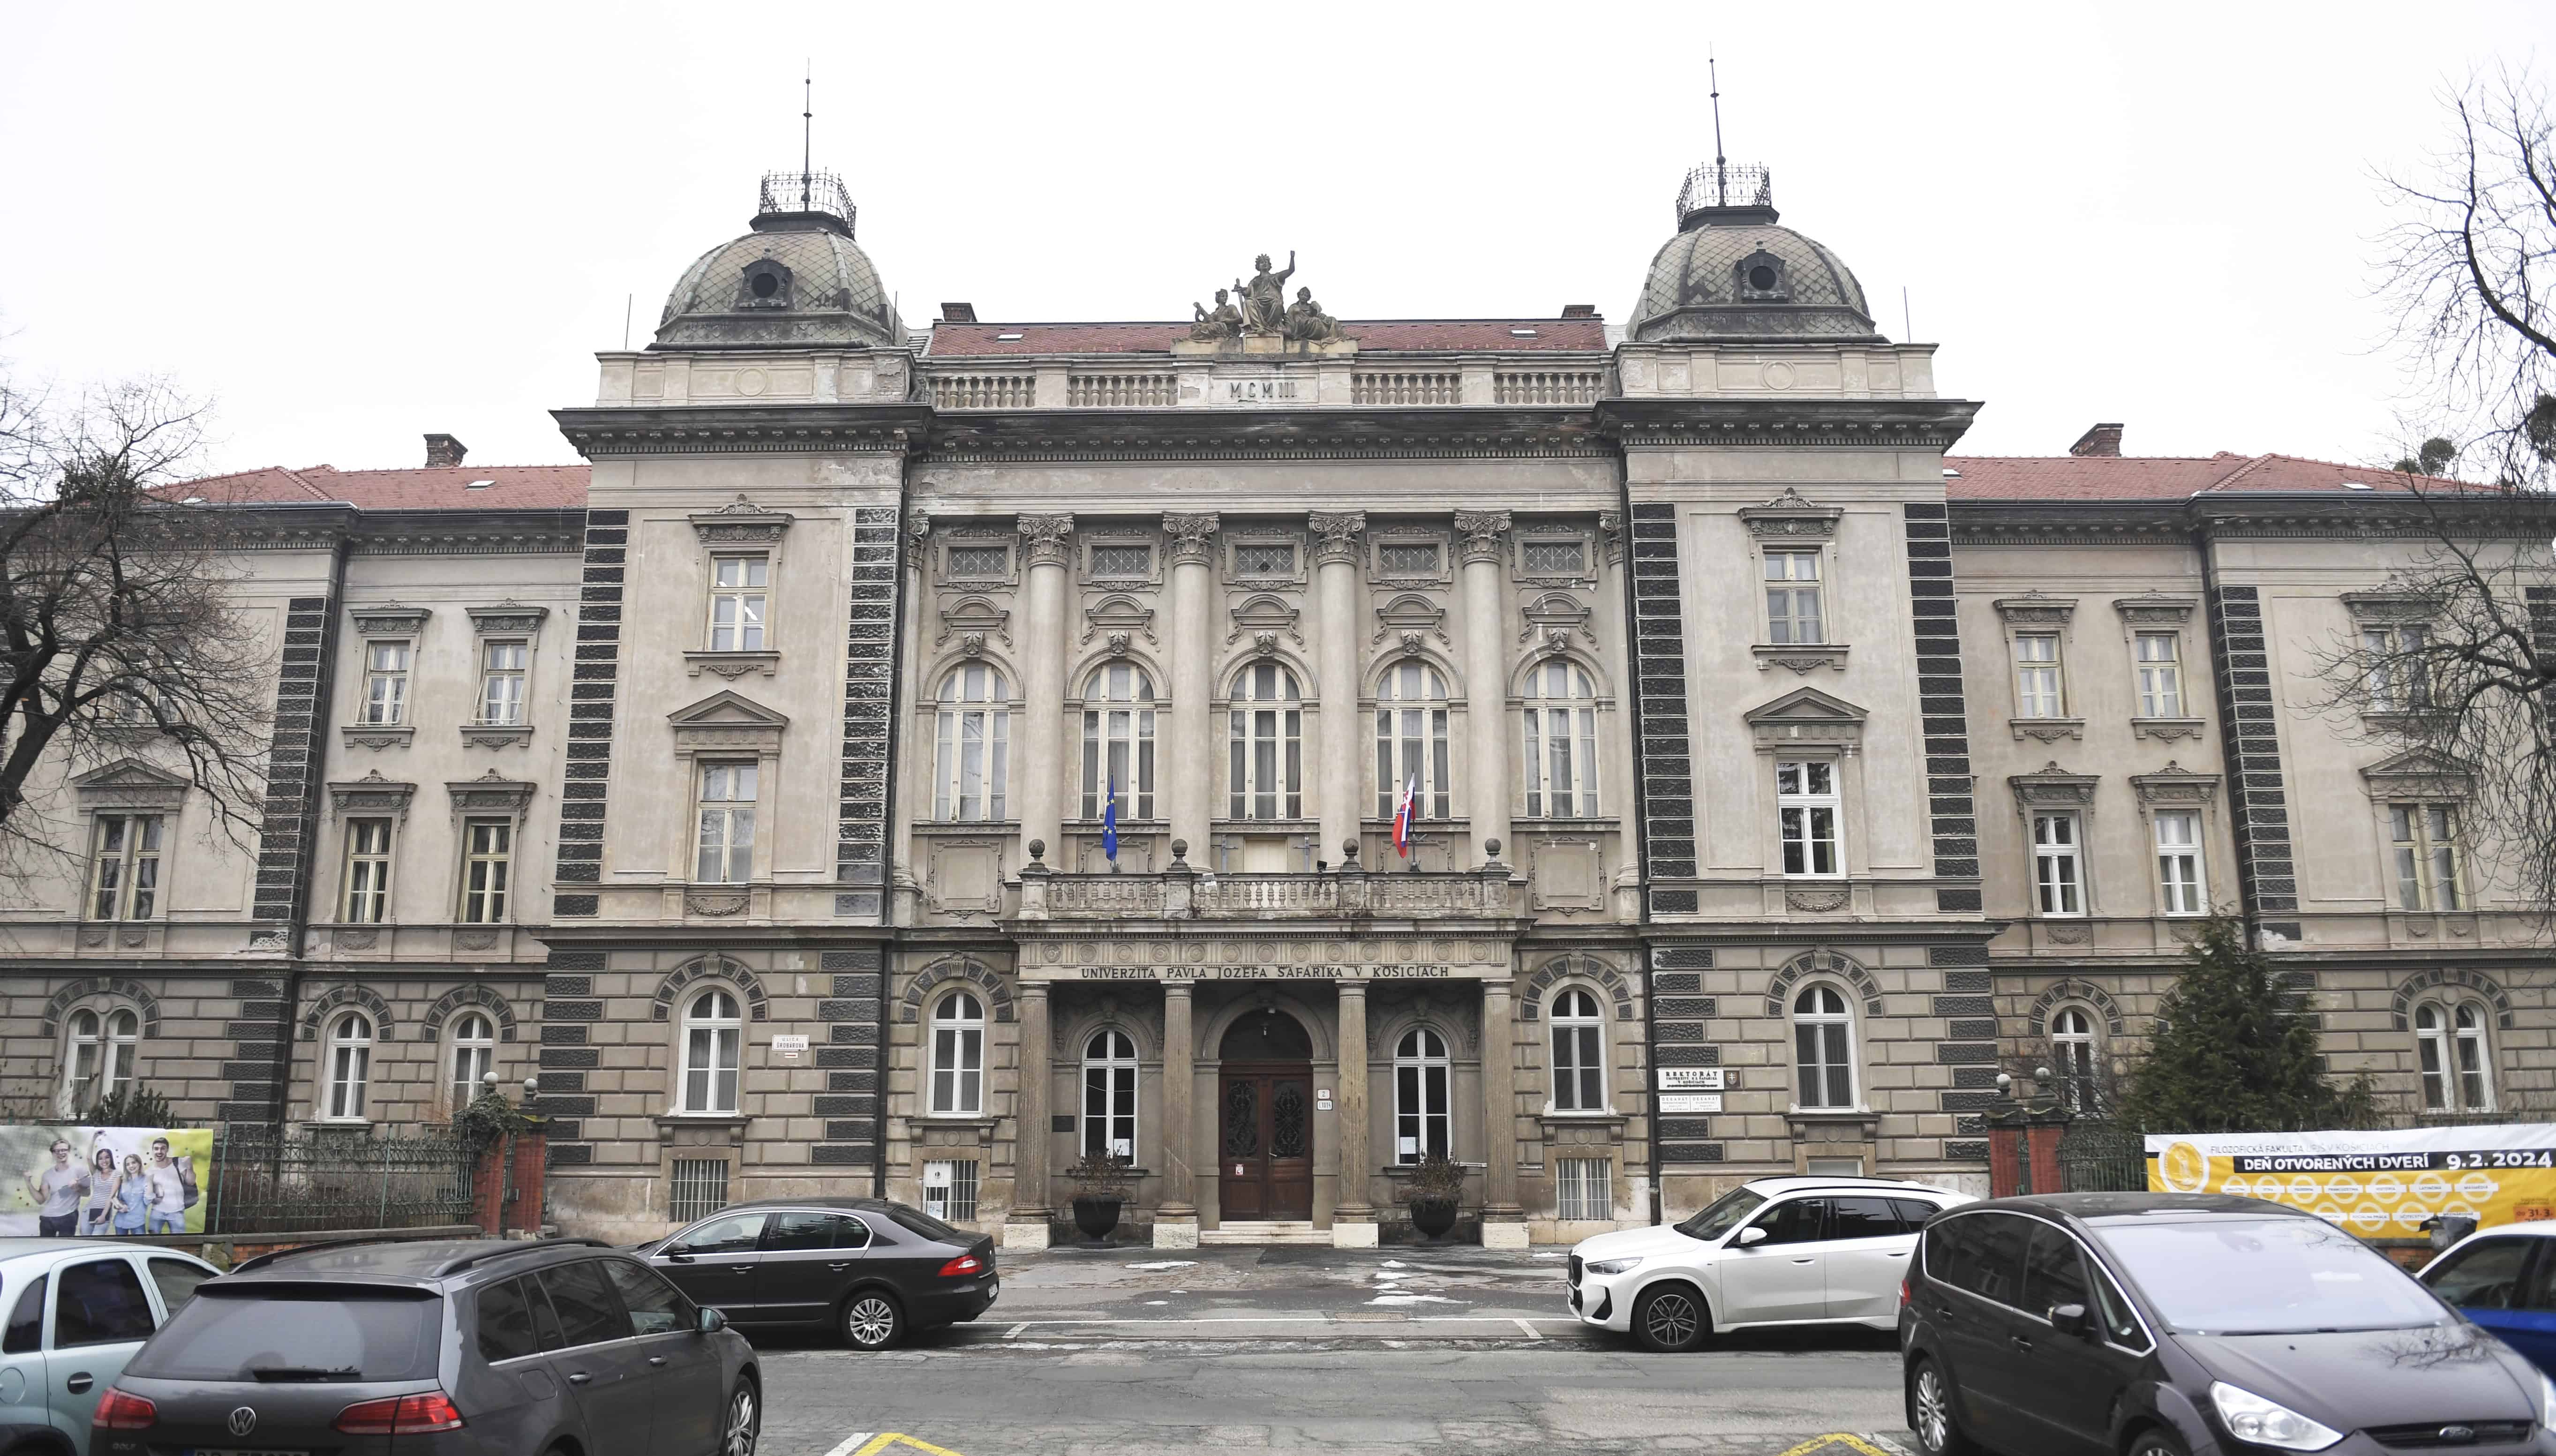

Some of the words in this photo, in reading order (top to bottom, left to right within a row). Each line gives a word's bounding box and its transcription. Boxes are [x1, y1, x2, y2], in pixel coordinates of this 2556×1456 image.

[1082, 968, 1156, 978] UNIVERZITA
[1166, 968, 1207, 978] PAVLA
[1217, 967, 1268, 979] JOZEFA
[1354, 967, 1362, 976] V
[2210, 1144, 2263, 1154] FILOZOFICKÁ
[2265, 1145, 2303, 1153] FAKULTA
[2244, 1156, 2272, 1171] DEŇ
[2274, 1155, 2375, 1171] OTVORENÝCH
[2379, 1153, 2429, 1169] DVERÍ
